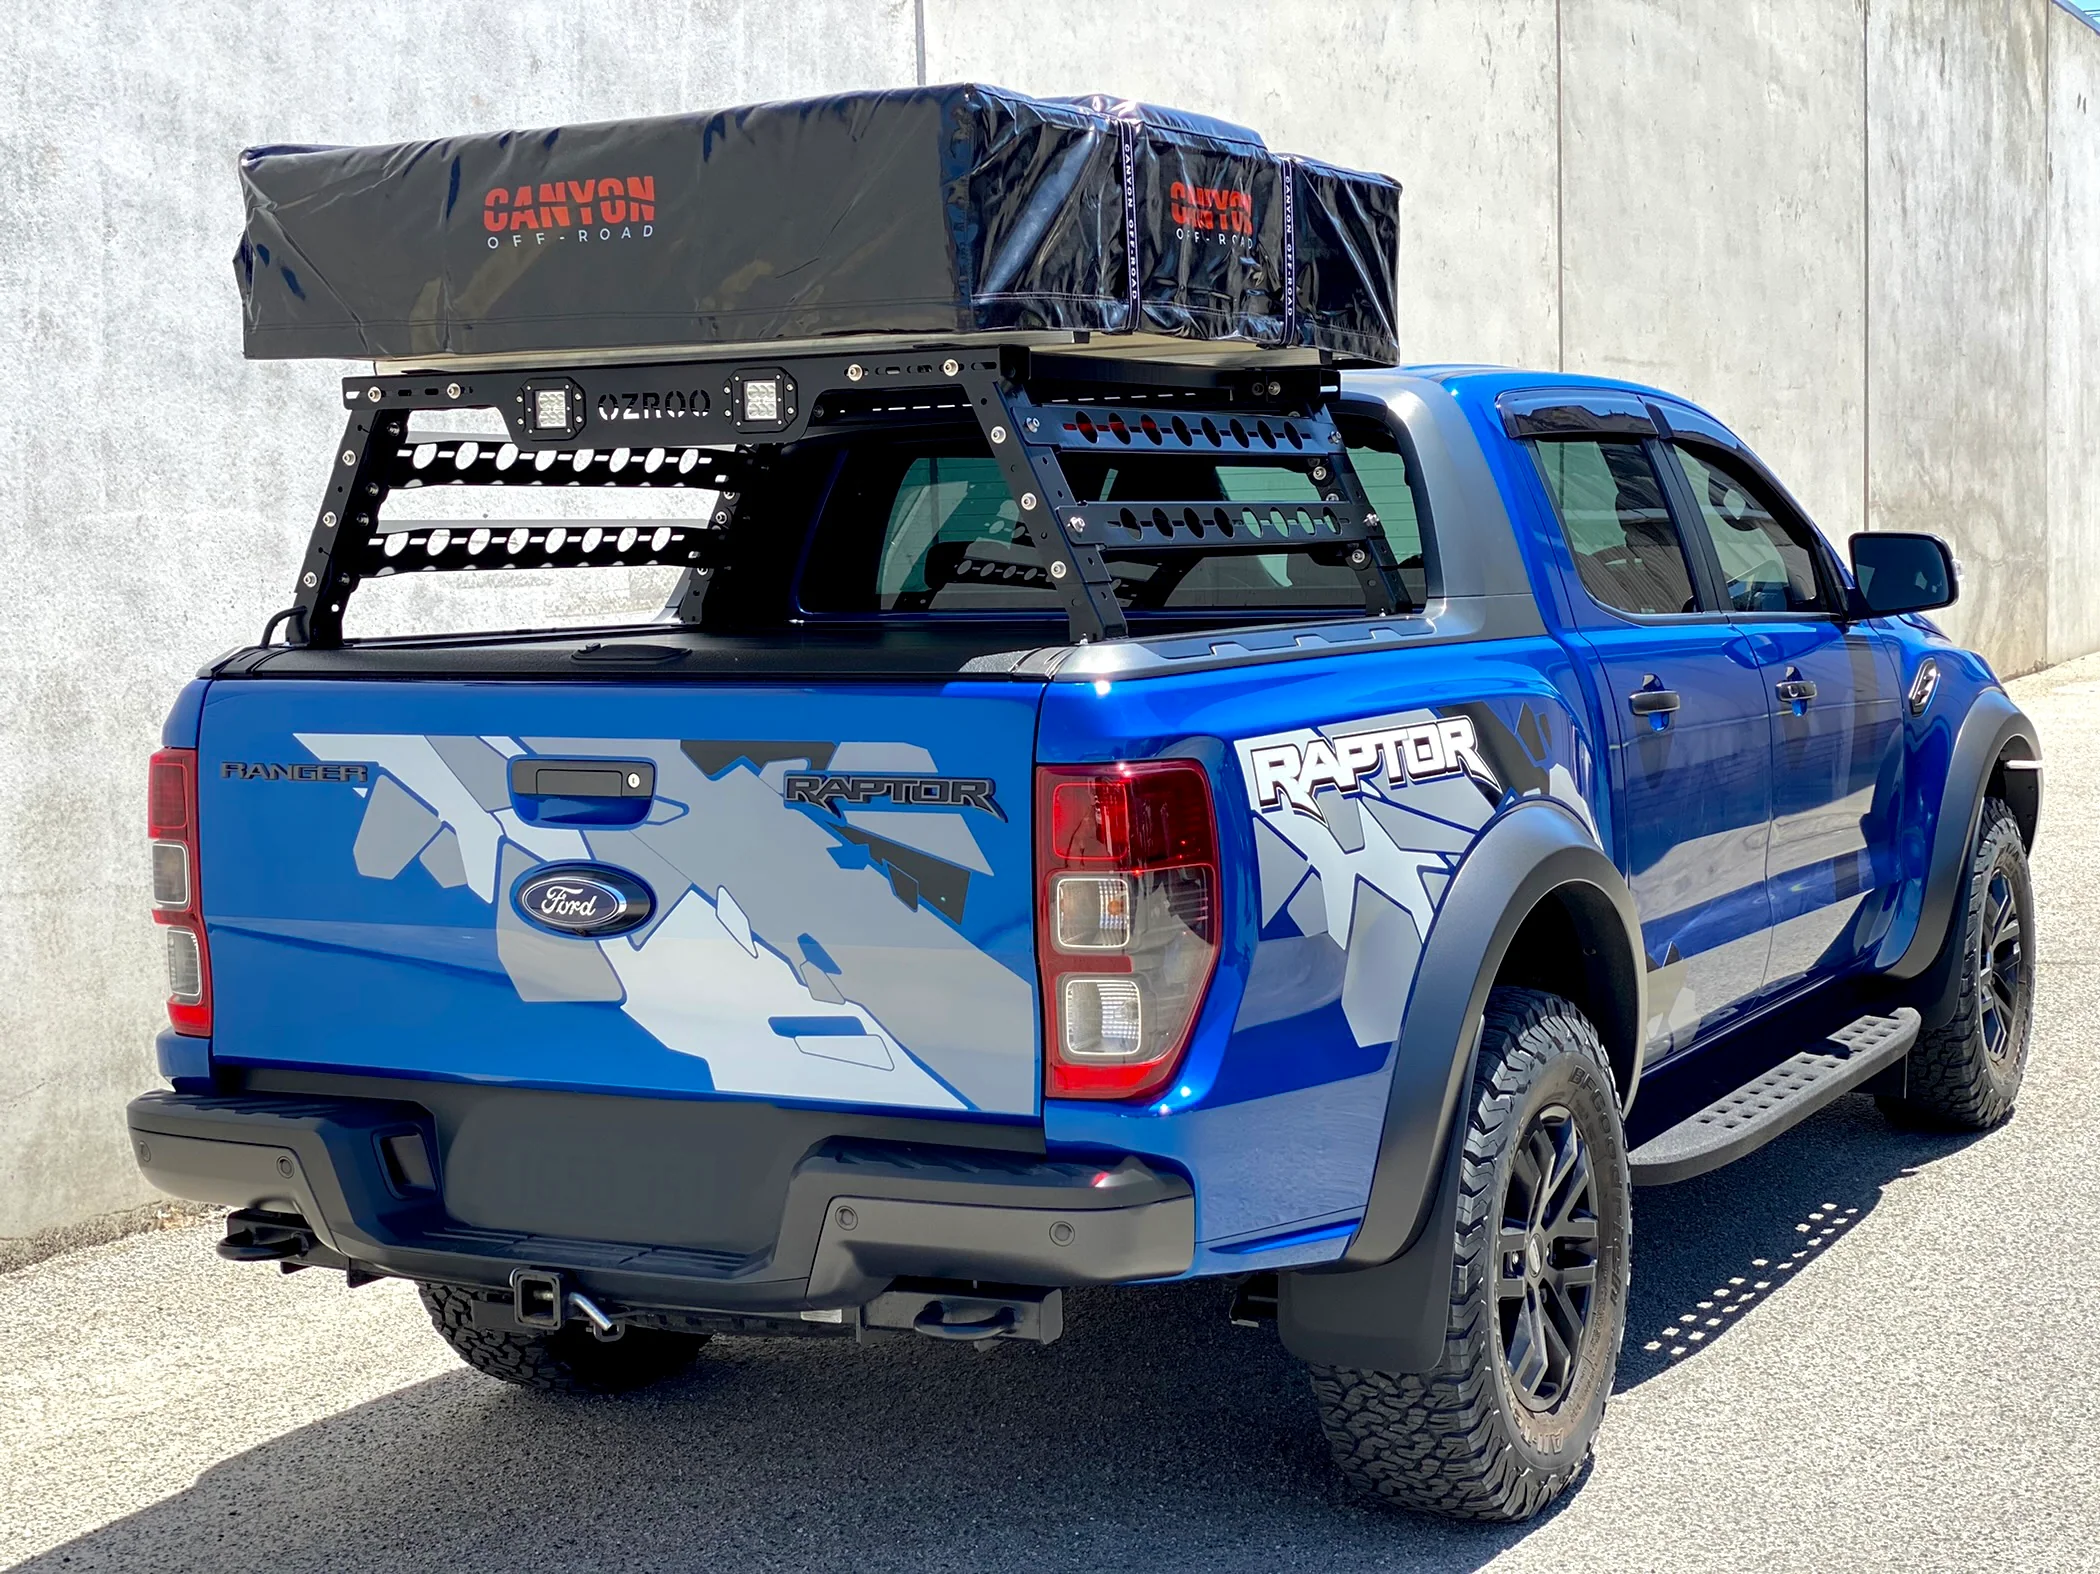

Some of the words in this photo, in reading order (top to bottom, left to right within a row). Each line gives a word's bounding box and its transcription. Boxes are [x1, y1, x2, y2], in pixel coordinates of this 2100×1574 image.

[1124, 143, 1134, 208] CANYON
[483, 176, 655, 232] CANYON
[1170, 181, 1253, 236] CANYON
[1285, 176, 1293, 233] CANYON
[487, 225, 653, 250] OFF-ROAD
[1128, 219, 1138, 300] OFF-ROAD
[1286, 243, 1294, 316] OFF-ROAD
[597, 389, 711, 421] OZROO
[220, 761, 369, 782] RANGER
[785, 774, 1008, 823] RAPTOR
[1250, 715, 1503, 827] RAPTOR
[541, 885, 598, 916] Ford
